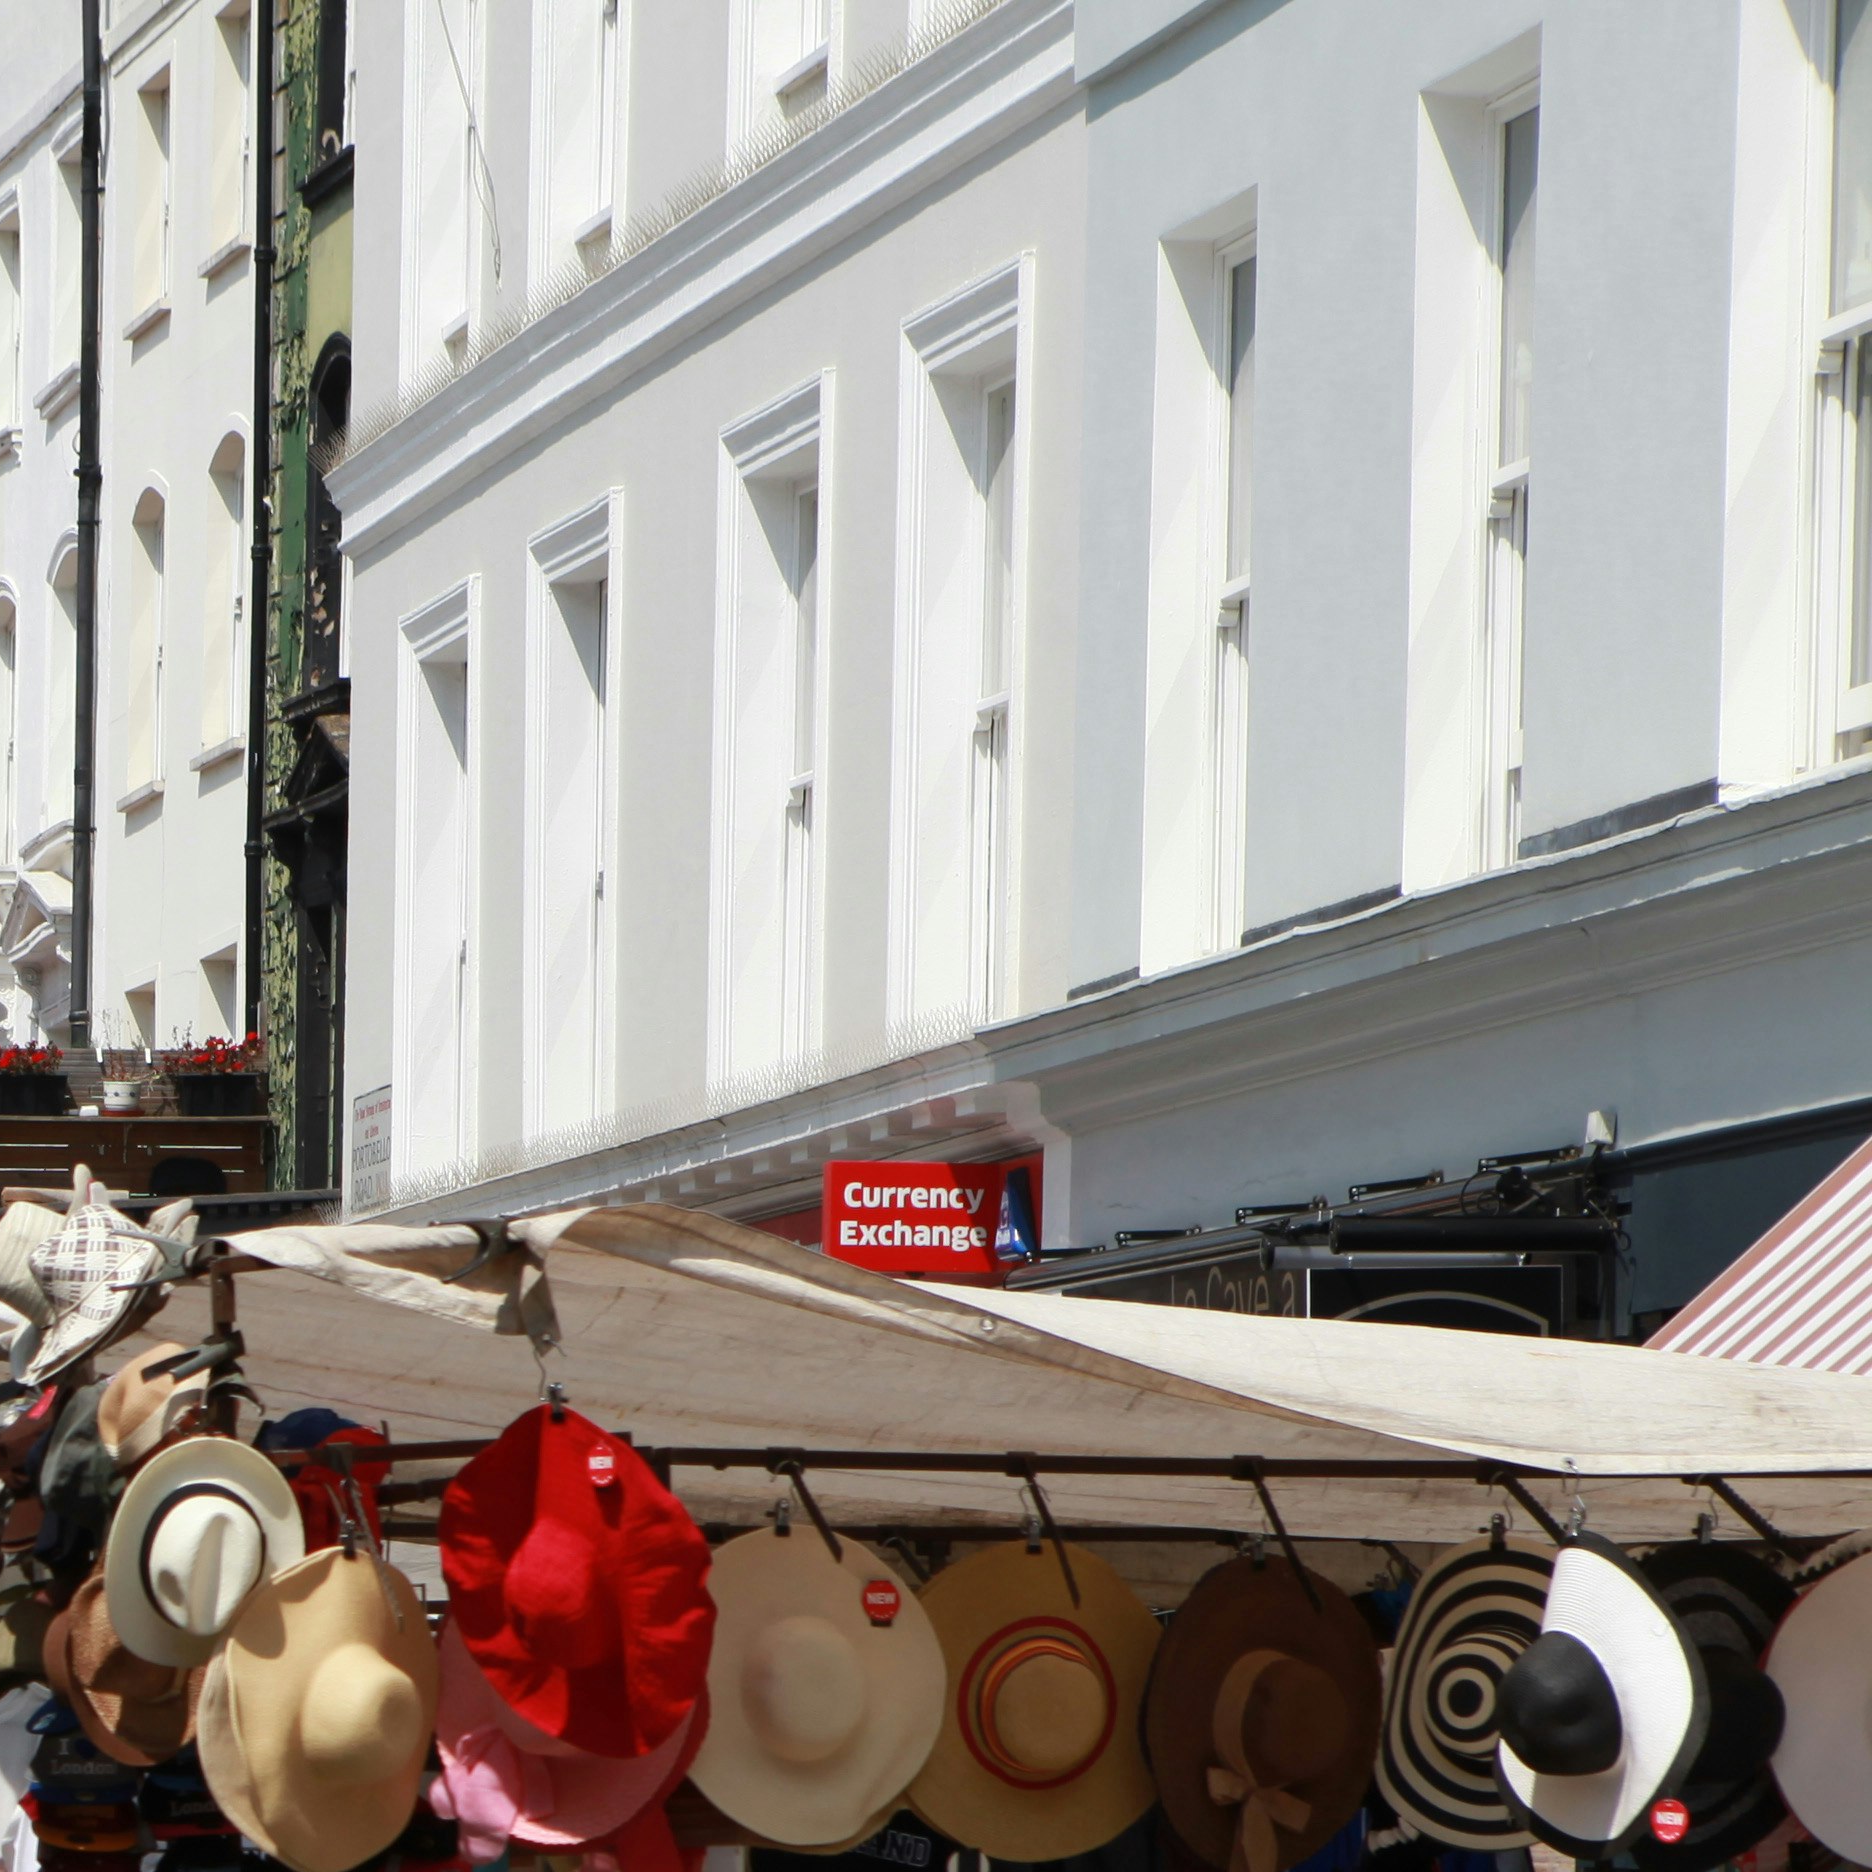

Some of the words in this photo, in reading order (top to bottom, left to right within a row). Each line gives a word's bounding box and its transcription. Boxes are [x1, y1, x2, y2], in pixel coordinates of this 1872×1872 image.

[844, 1182, 984, 1214] Currency
[840, 1220, 987, 1252] Exchange
[588, 1456, 614, 1469] NEW
[866, 1592, 896, 1604] NEW
[1656, 1811, 1685, 1826] NEW
